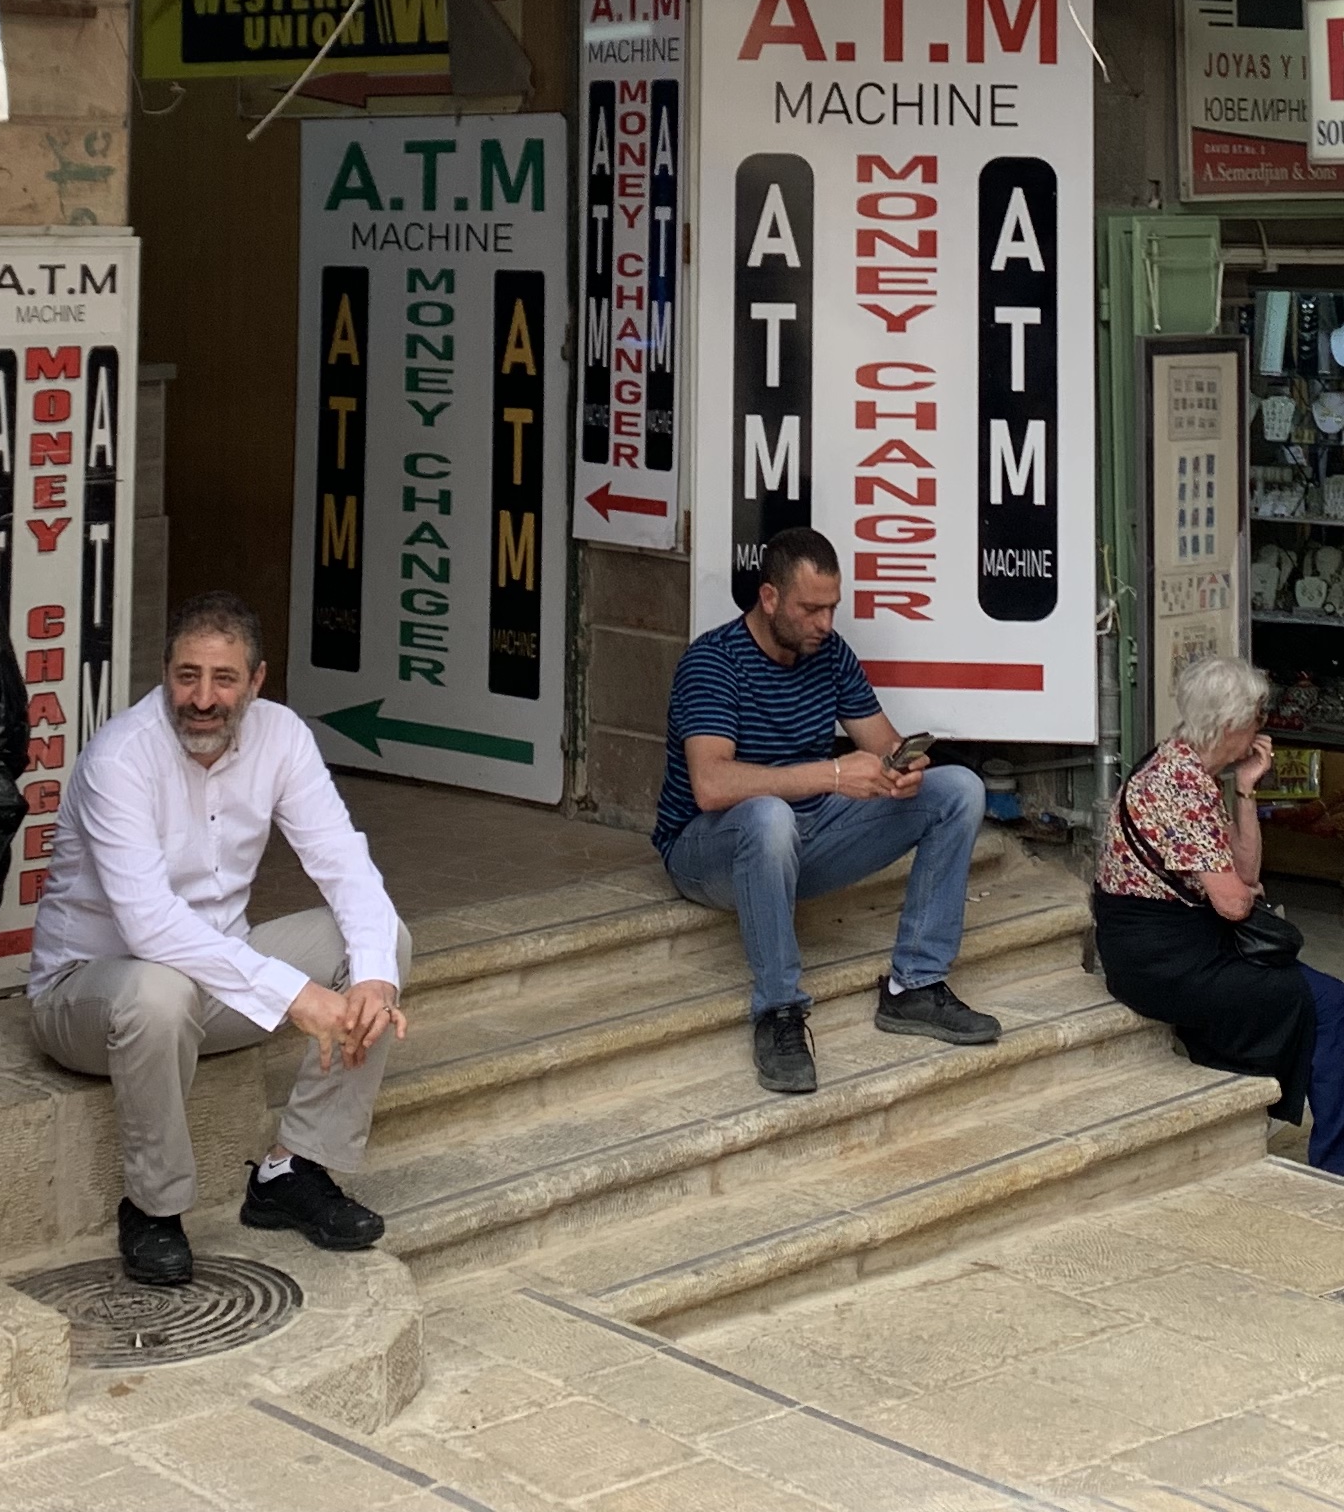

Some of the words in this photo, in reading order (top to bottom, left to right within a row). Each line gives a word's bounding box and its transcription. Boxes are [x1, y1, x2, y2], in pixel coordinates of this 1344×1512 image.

[244, 12, 365, 50] UNION
[587, 38, 680, 65] MACHINE
[775, 81, 1019, 128] MACHINE
[1204, 52, 1271, 79] JOYAS
[1281, 54, 1293, 80] Y
[324, 137, 546, 213] A.T.M
[351, 222, 514, 254] MACHINE
[587, 105, 610, 369] ATM
[618, 80, 648, 230] MONEY
[650, 105, 675, 374] ATM
[16, 304, 86, 323] MACHINE
[856, 154, 938, 334] MONEY
[406, 267, 455, 428] MONEY
[612, 252, 645, 470] CHANGER
[744, 183, 803, 501] ATM
[989, 187, 1047, 507] ATM
[25, 345, 81, 553] MONEY
[321, 292, 360, 570] ATM
[498, 297, 537, 592] ATM
[854, 361, 937, 622] CHANGER
[398, 452, 452, 688] CHANGER
[492, 628, 537, 659] MACHINE
[982, 548, 1053, 579] MACHINE
